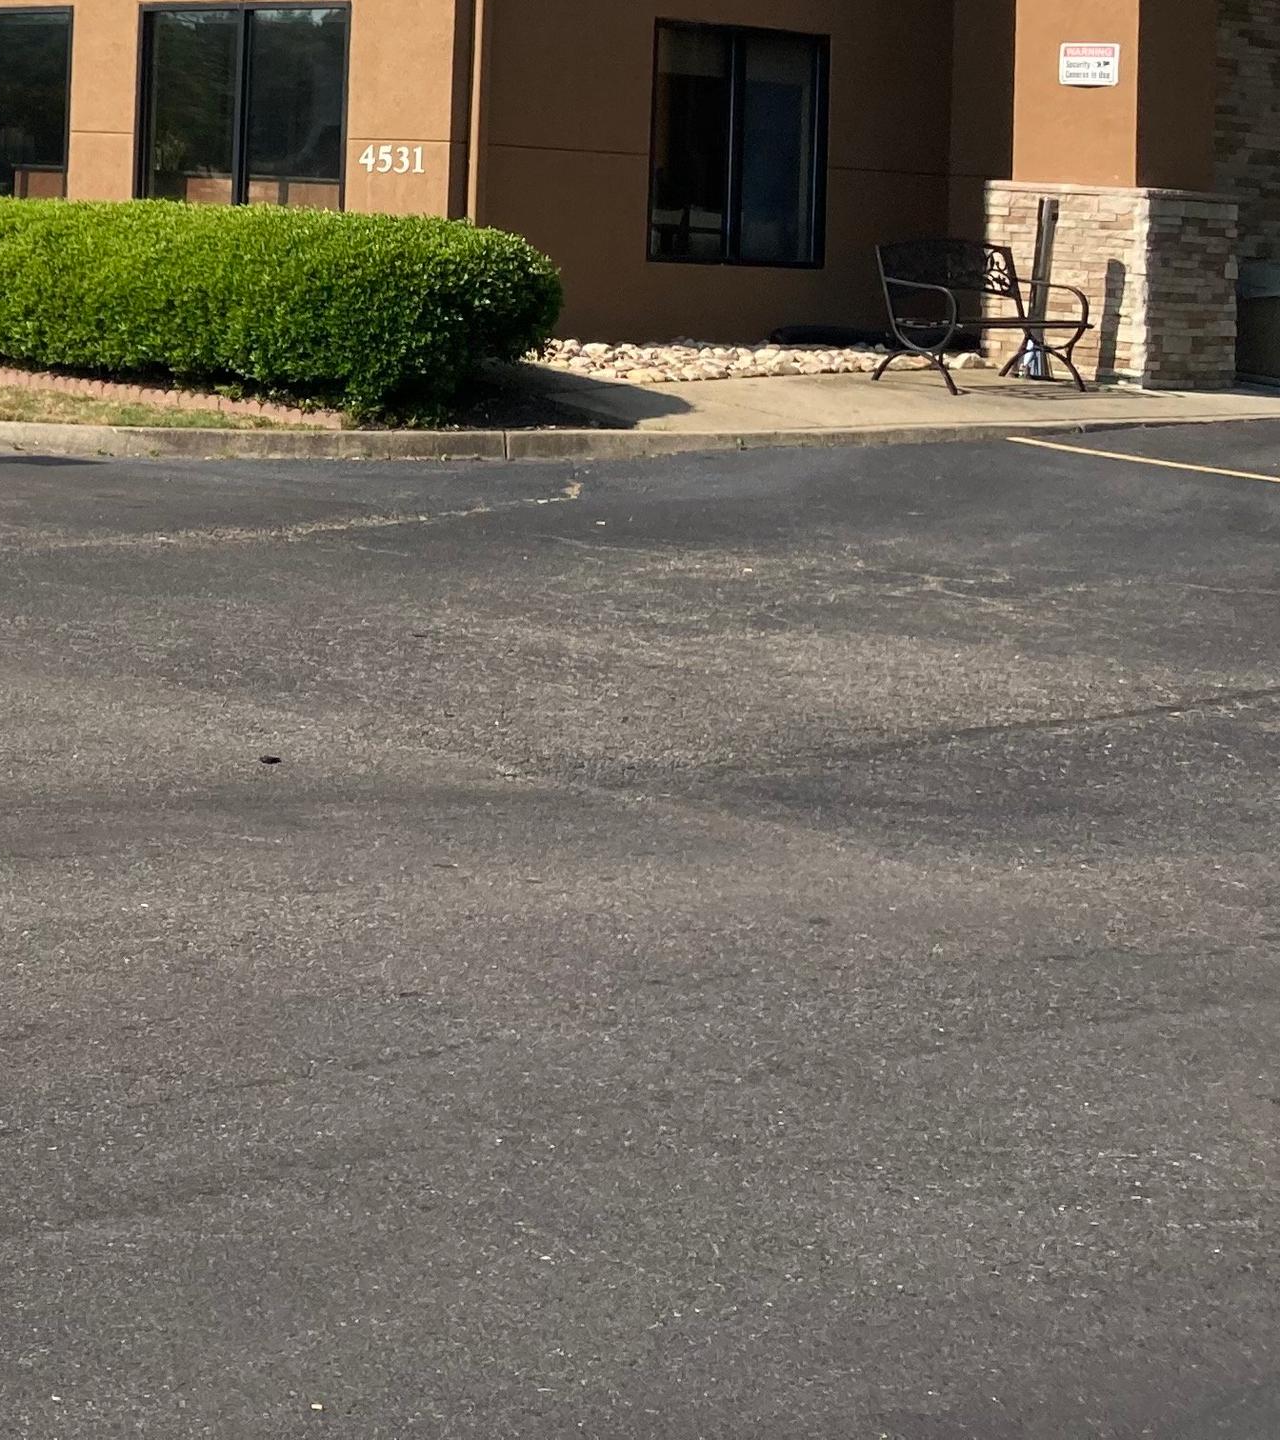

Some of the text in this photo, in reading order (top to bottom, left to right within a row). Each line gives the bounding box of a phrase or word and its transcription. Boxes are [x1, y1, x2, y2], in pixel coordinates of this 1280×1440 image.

[1065, 47, 1114, 57] WARNING
[1066, 61, 1090, 69] Security
[1065, 71, 1089, 79] Cameras
[358, 144, 426, 174] 4531
